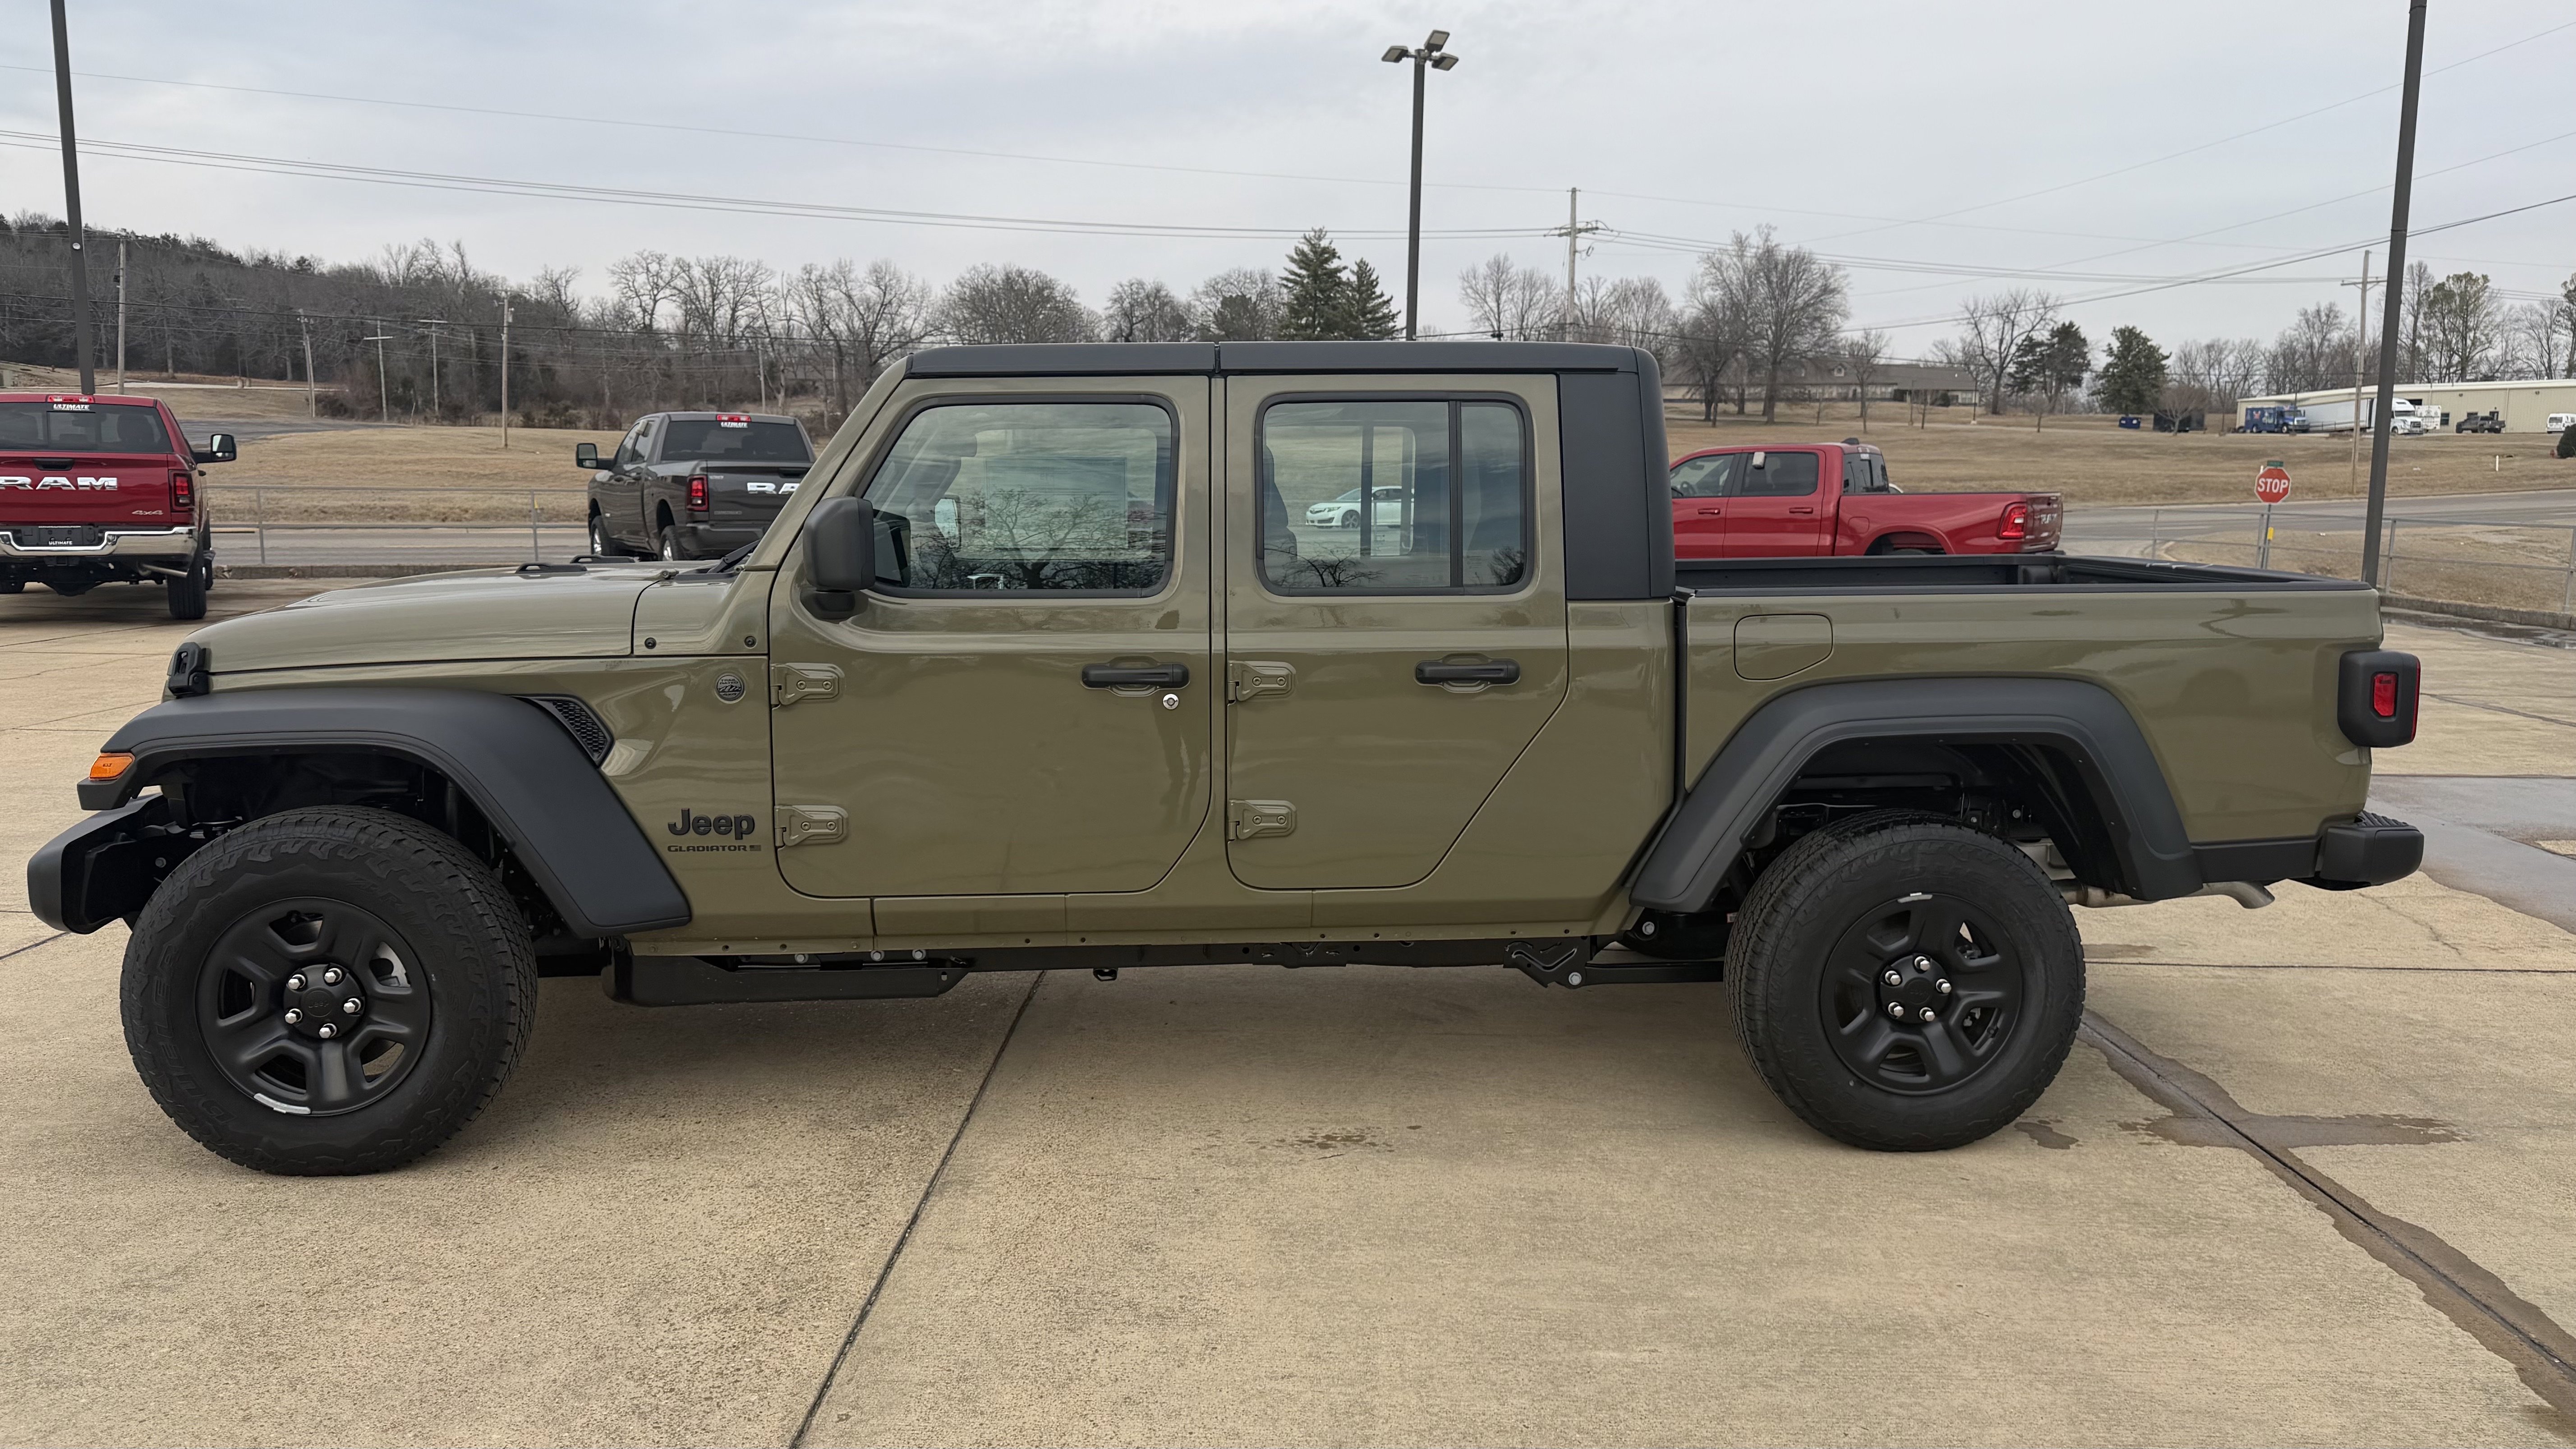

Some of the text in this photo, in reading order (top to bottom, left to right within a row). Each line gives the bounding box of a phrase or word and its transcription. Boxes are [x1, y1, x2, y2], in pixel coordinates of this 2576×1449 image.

[0, 476, 118, 490] RAM
[747, 482, 800, 494] RA
[2257, 478, 2289, 493] STOP
[668, 808, 755, 840] Jeep
[152, 943, 238, 1125] DUELER
